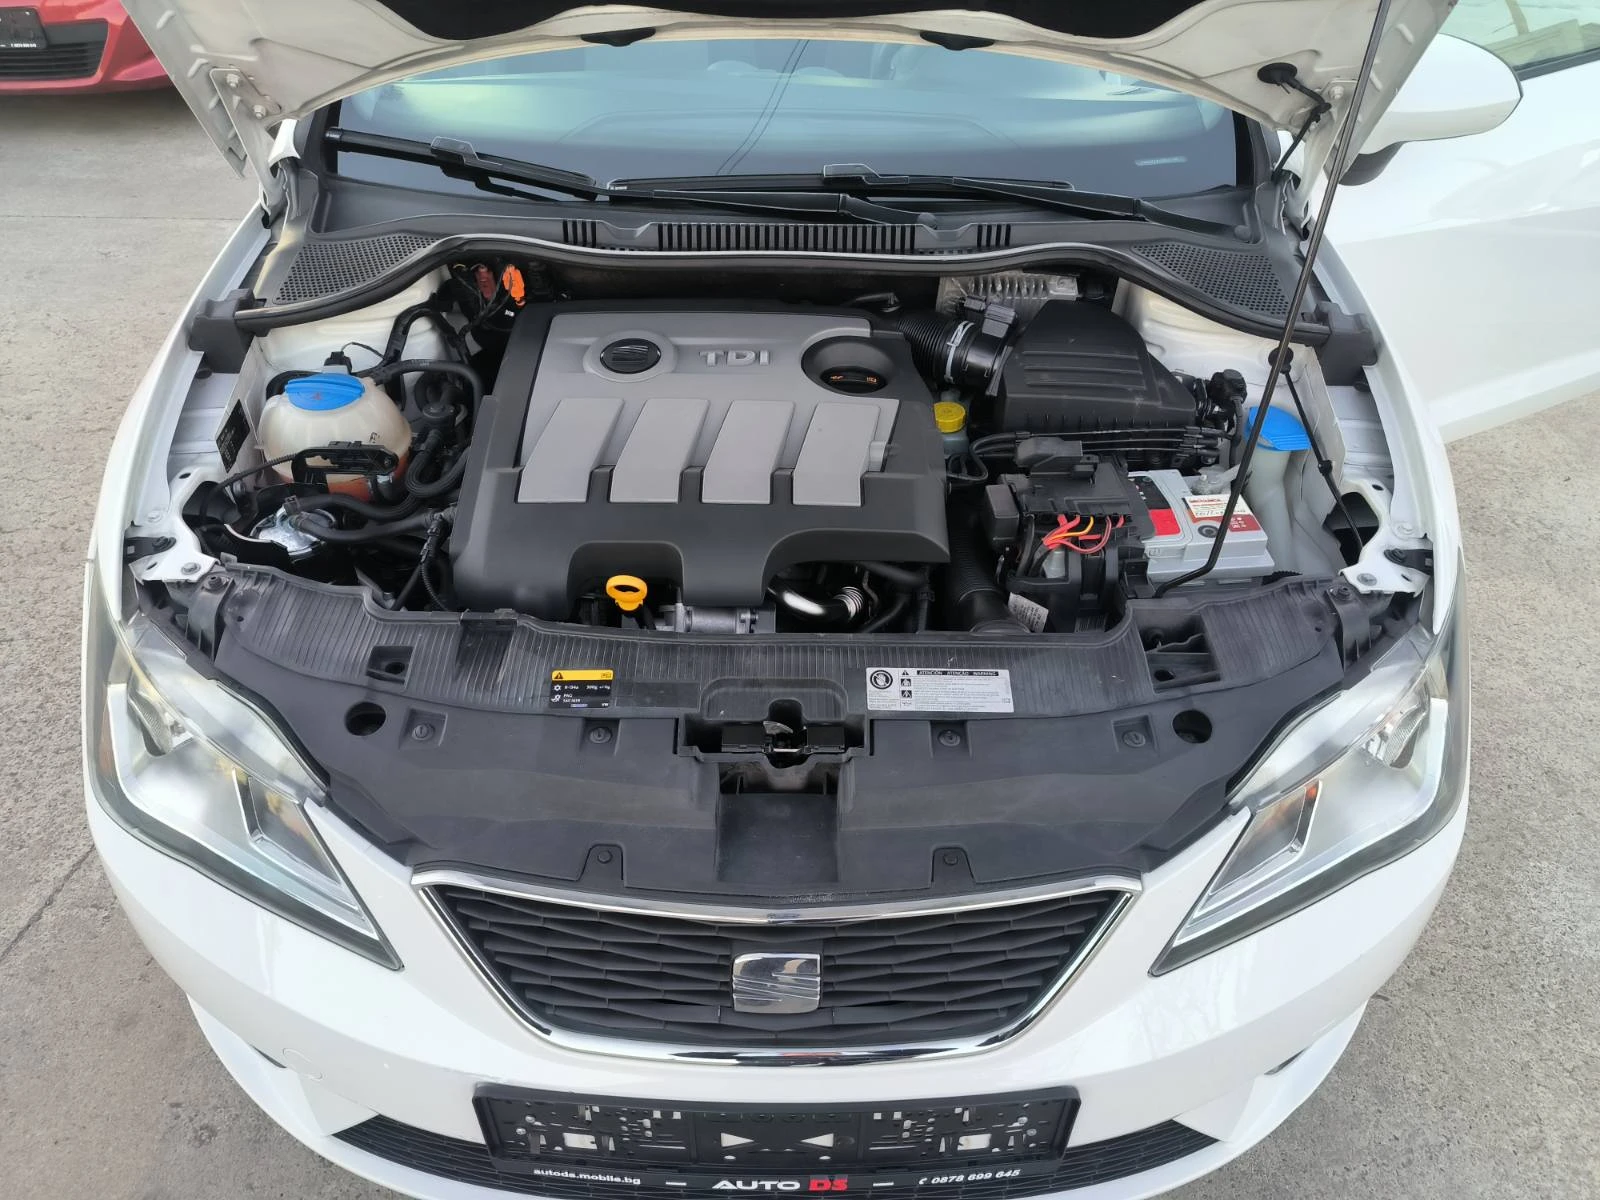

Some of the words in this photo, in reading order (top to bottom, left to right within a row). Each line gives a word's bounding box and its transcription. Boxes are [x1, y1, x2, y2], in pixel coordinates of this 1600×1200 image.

[699, 350, 769, 367] TDI
[931, 1175, 965, 1184] 0878
[967, 1173, 992, 1181] 699
[995, 1169, 1021, 1178] 645
[711, 1180, 801, 1191] AUTO
[809, 1179, 848, 1191] DS
